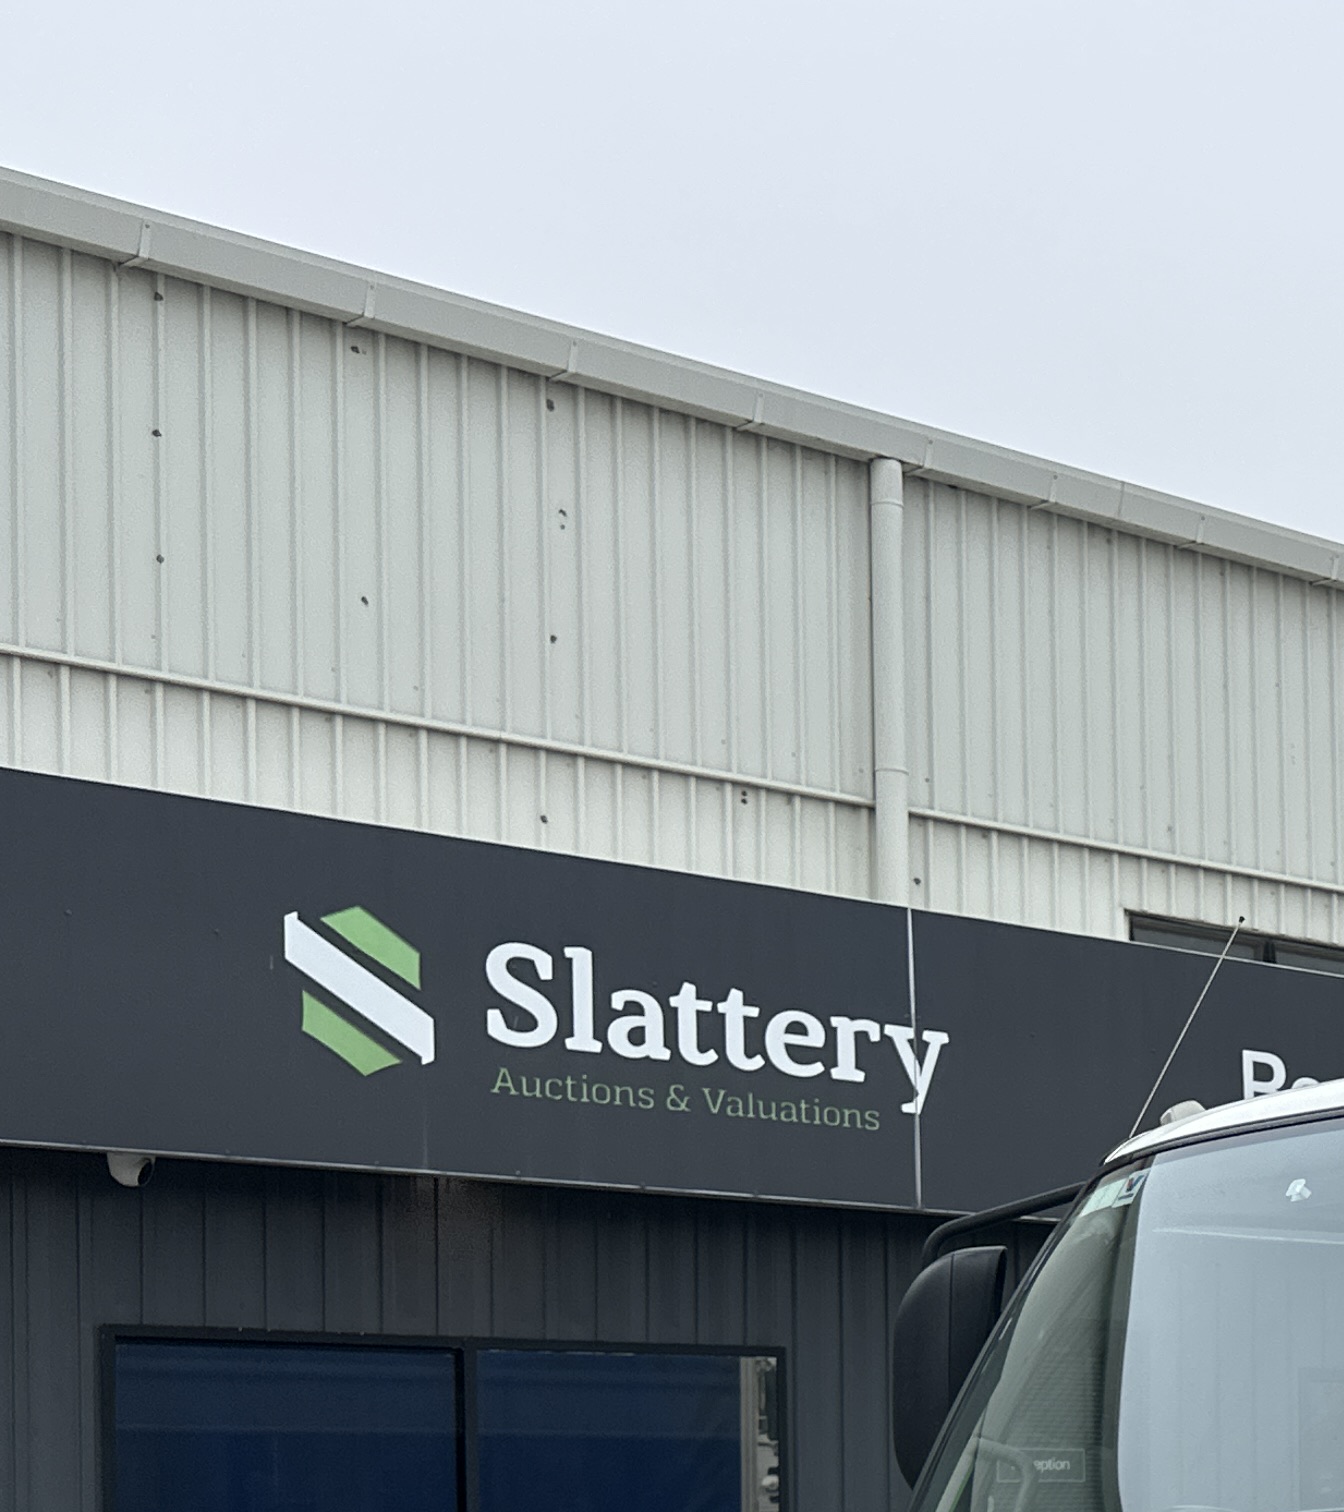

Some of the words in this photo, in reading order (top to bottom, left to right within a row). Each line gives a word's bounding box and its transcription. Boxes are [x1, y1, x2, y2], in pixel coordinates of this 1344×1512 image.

[485, 942, 949, 1114] Slattery
[490, 1066, 656, 1111] Auctions
[666, 1084, 692, 1113] &
[702, 1087, 881, 1130] Valuations
